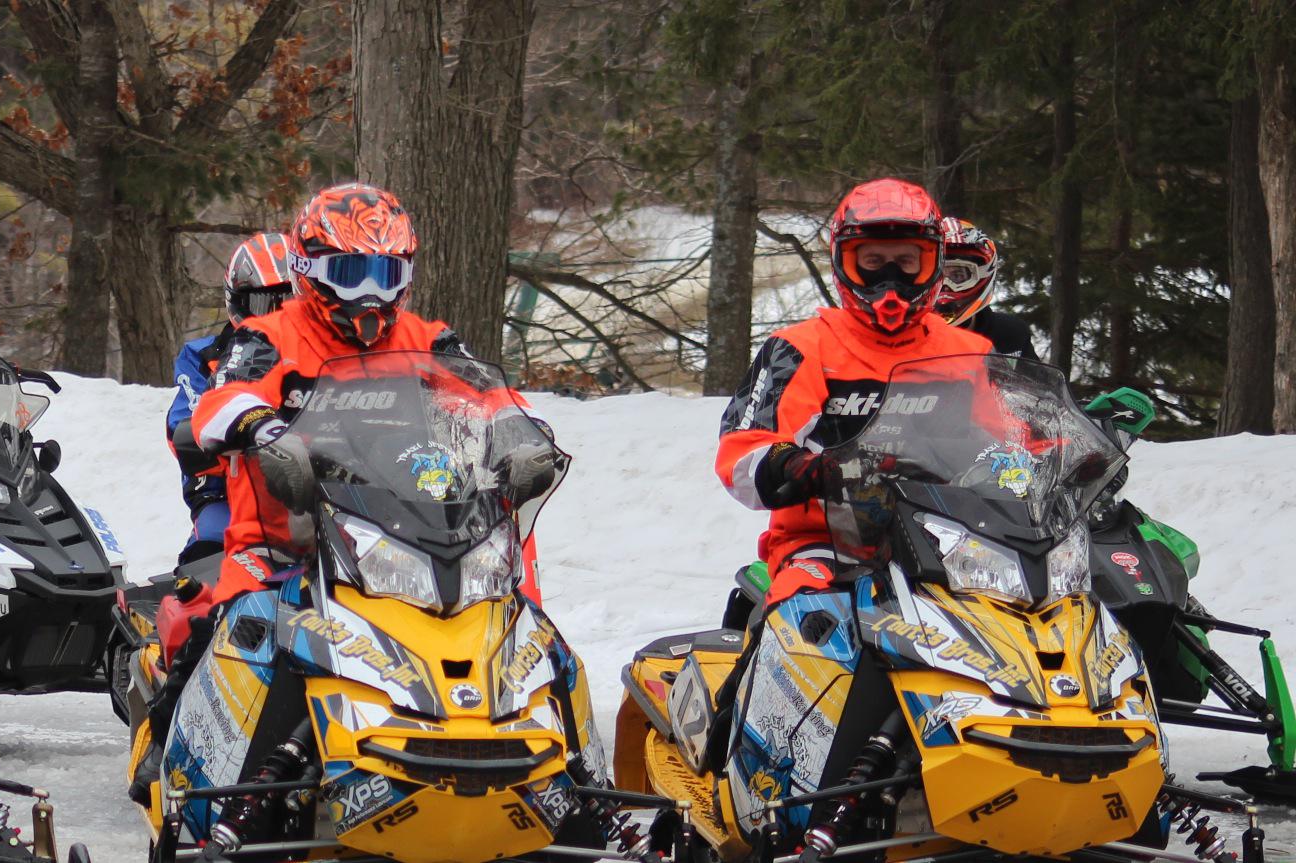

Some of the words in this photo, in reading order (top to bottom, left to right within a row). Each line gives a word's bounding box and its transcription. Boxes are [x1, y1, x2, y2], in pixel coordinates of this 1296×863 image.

[736, 368, 768, 430] ski-do
[287, 609, 354, 643] Coutts
[871, 614, 950, 647] Coutts
[794, 690, 835, 738] Raing
[339, 774, 390, 818] XPS
[537, 783, 570, 820] XPS
[968, 789, 1019, 823] RS
[1102, 792, 1128, 821] RS
[371, 800, 419, 834] RS
[501, 802, 537, 831] RS
